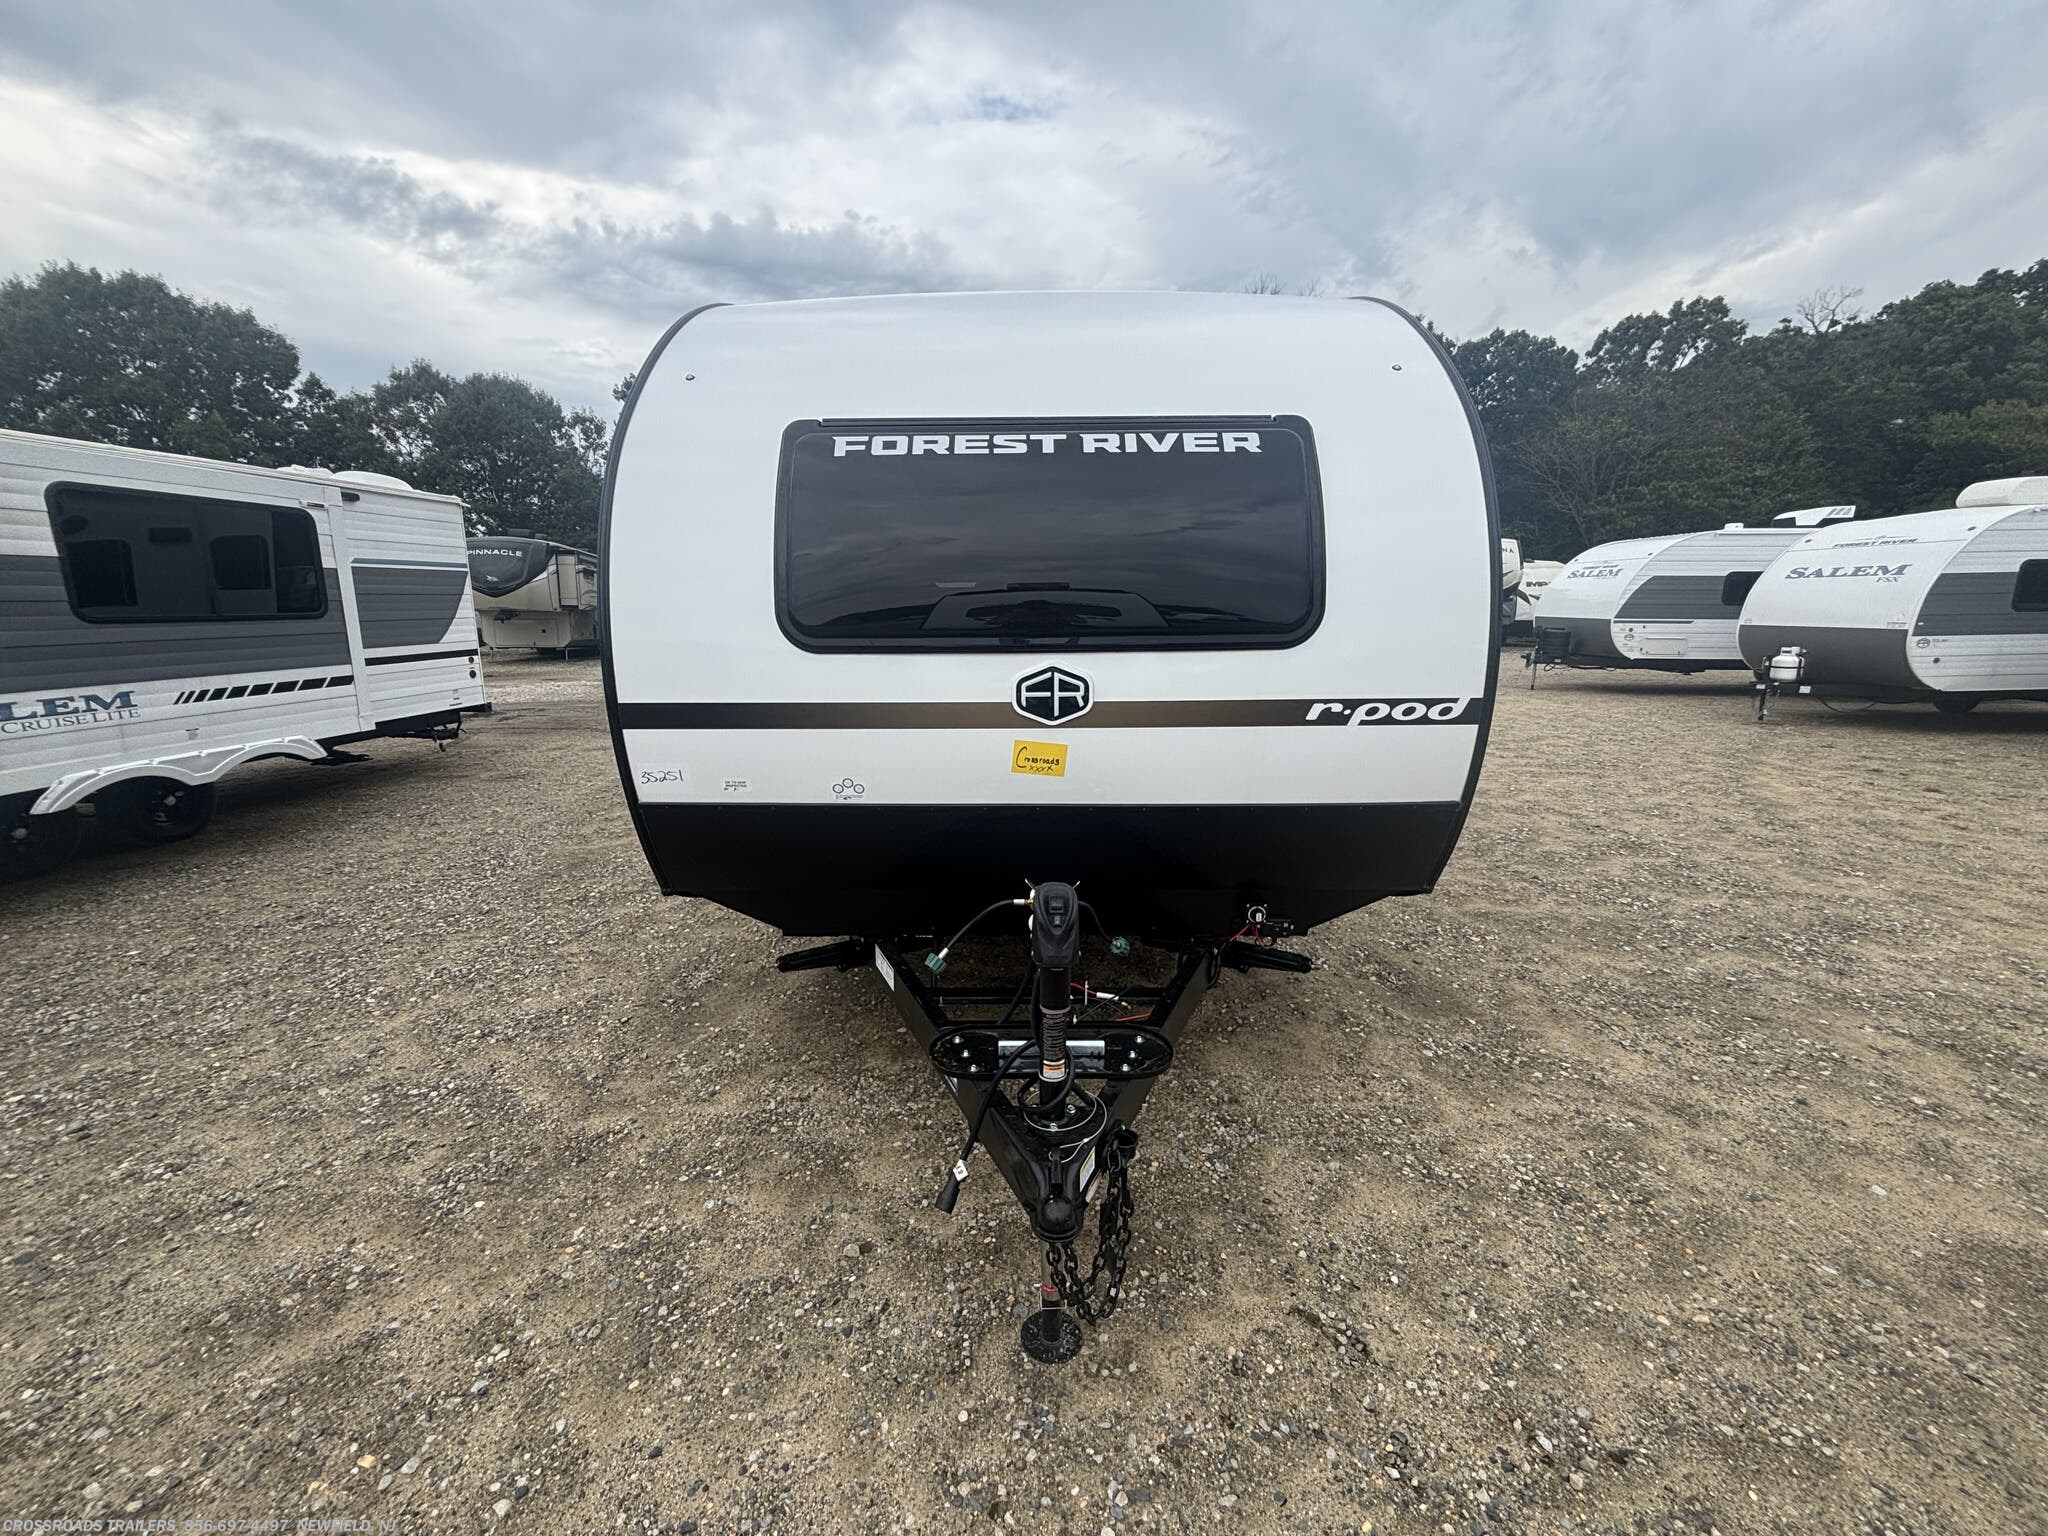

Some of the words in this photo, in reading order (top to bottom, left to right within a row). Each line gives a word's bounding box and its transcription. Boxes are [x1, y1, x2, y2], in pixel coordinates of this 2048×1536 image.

[832, 434, 1067, 457] FOREST
[1079, 432, 1263, 453] RIVER
[1567, 568, 1624, 579] SALEM
[1784, 564, 1912, 580] SALEM
[641, 769, 684, 784] 35251
